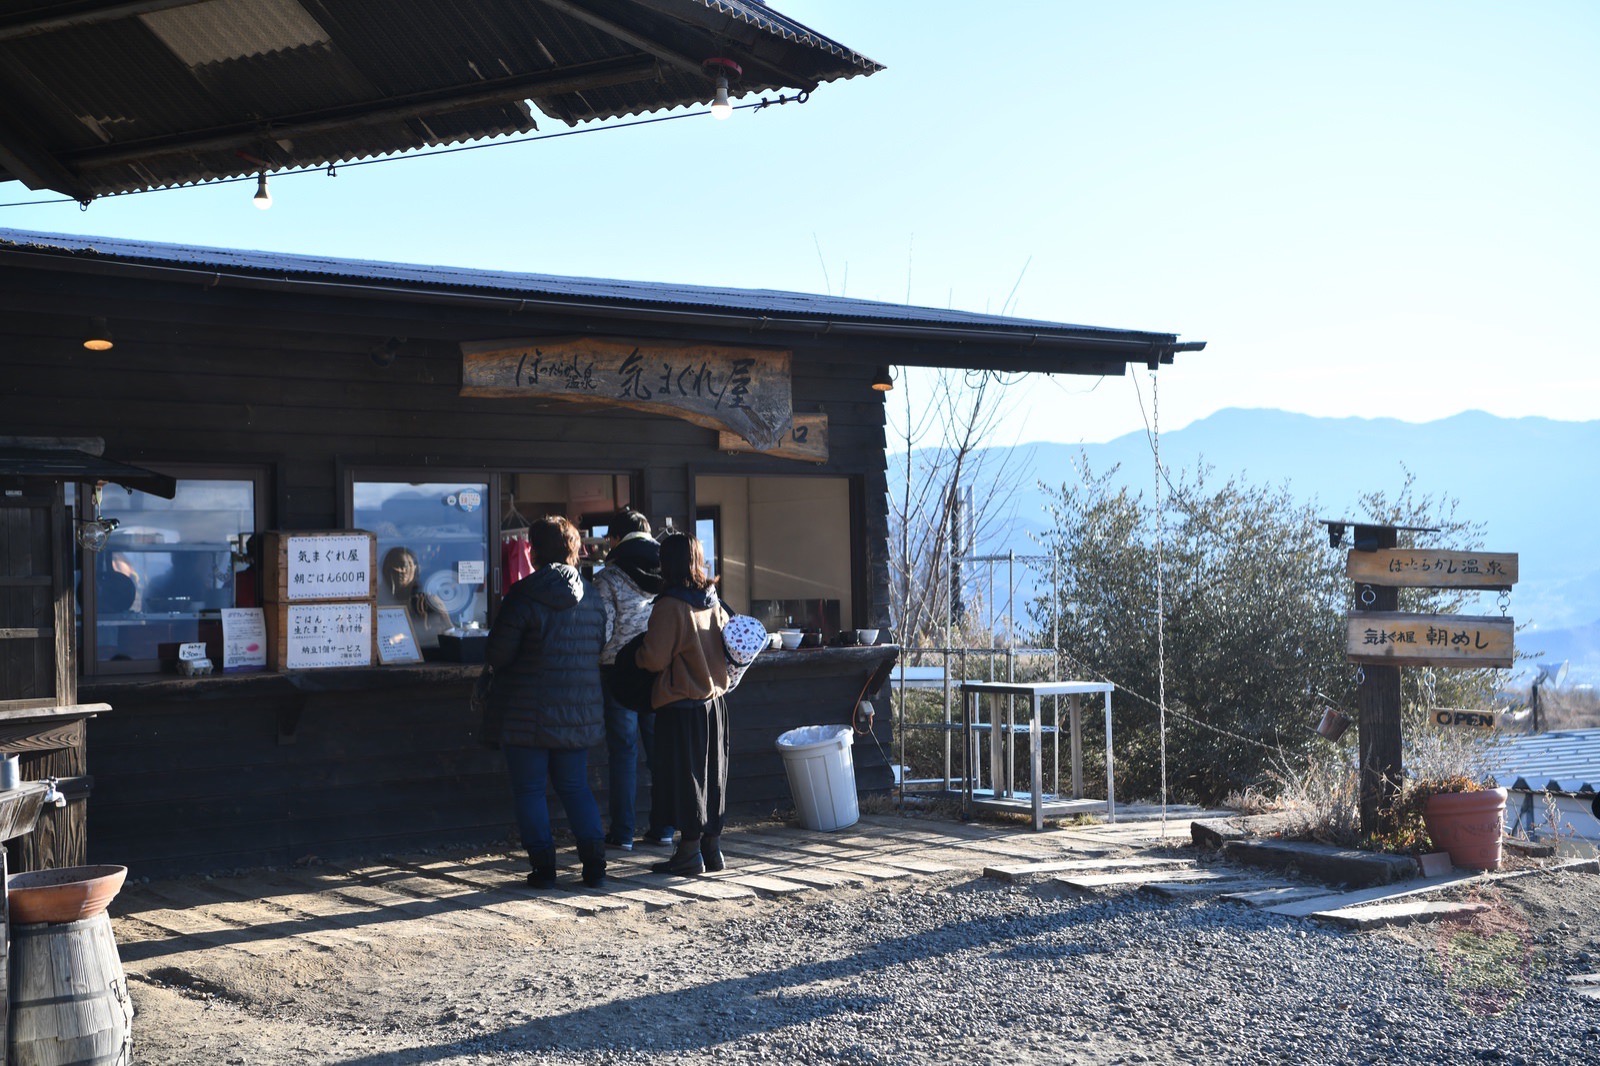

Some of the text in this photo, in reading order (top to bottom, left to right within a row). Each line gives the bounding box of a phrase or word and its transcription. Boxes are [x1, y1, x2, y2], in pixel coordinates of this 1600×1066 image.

[618, 347, 756, 410] 気まぐれ屋
[298, 548, 359, 563] 気まぐれ屋
[1389, 557, 1507, 576] ほったらかし温泉
[293, 571, 365, 584] 朝ごはん600円
[1362, 626, 1488, 649] 気まぐれ屋 朝めし
[1437, 711, 1493, 727] OPEN
